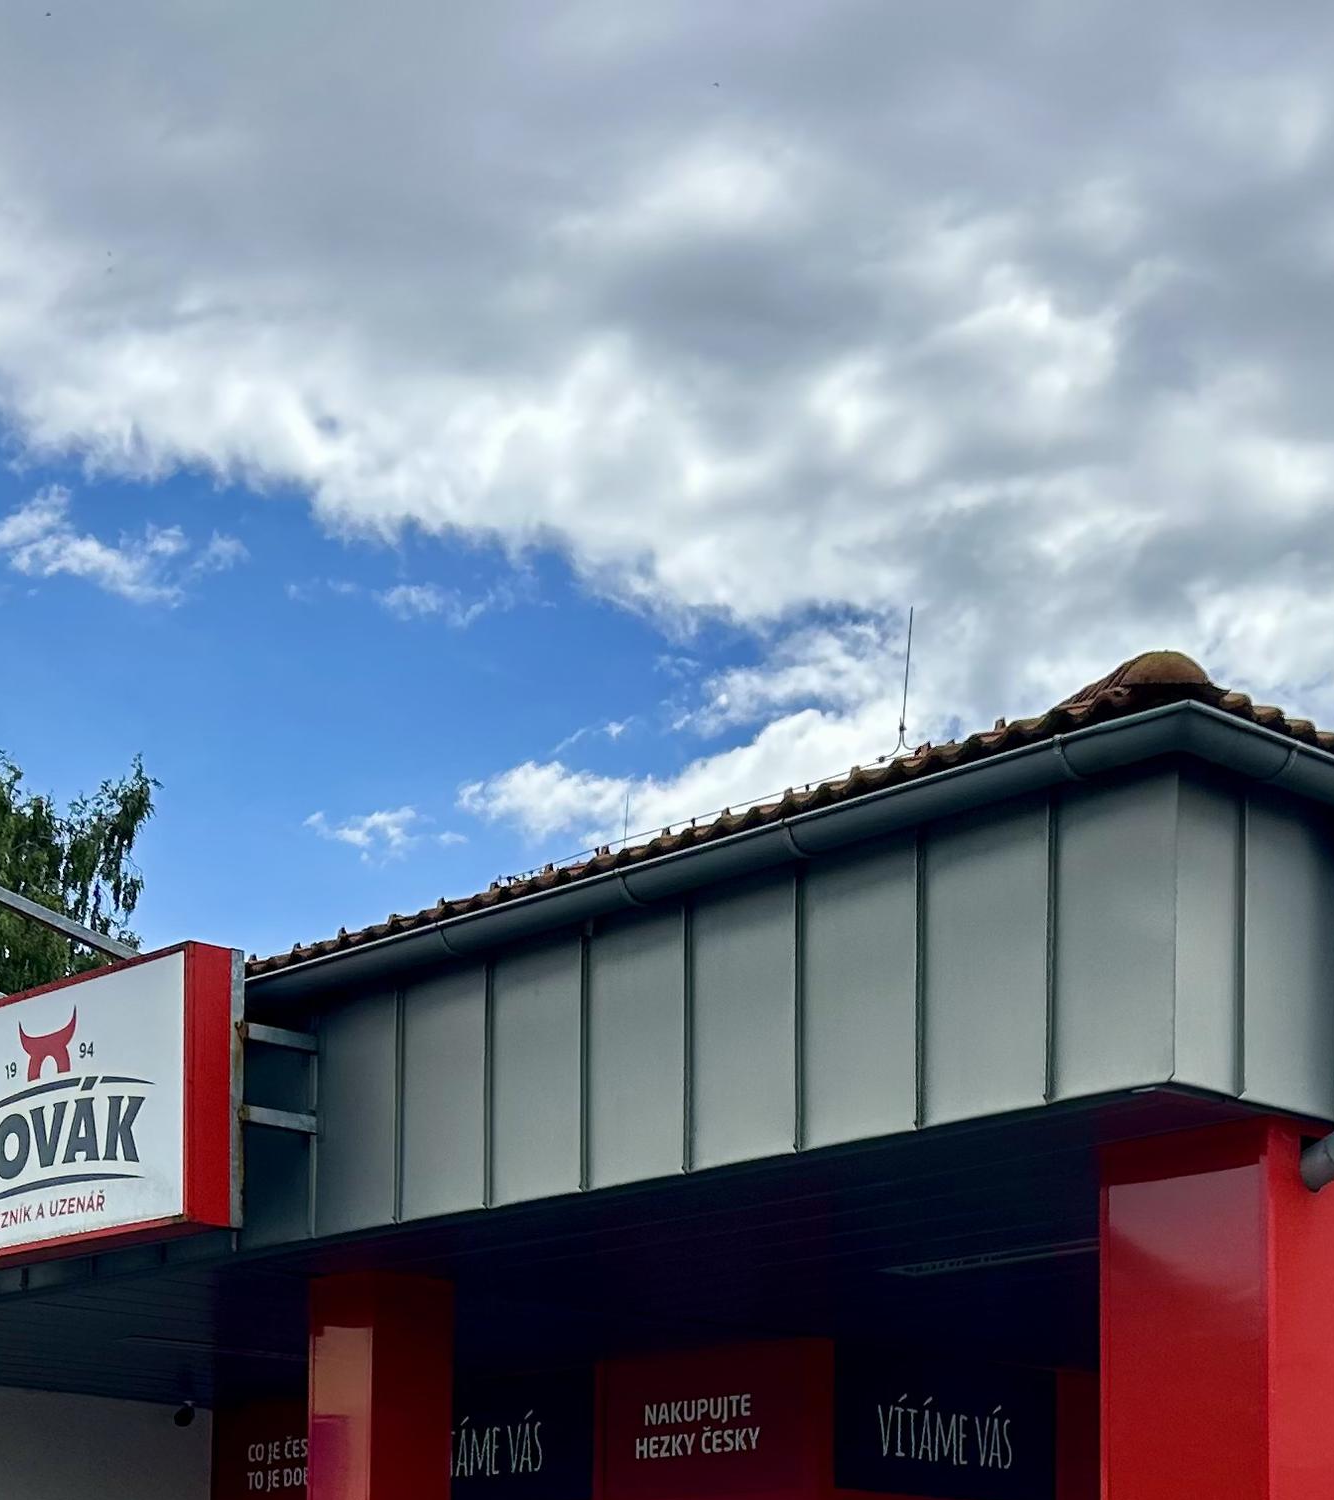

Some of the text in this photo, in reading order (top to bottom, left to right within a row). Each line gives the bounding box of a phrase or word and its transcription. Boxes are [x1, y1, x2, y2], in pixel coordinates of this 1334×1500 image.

[5, 1042, 94, 1079] 19 94
[35, 1203, 45, 1219] A
[49, 1189, 105, 1217] UZENÁŘ
[644, 1393, 752, 1426] NAKUPUJTE
[507, 1409, 543, 1474] VÁS
[635, 1426, 761, 1460] HEZKY ČESKY
[877, 1393, 1013, 1469] VÍTÁME VÁS
[248, 1443, 265, 1462] CO
[267, 1441, 281, 1464] JE
[247, 1471, 264, 1490] TO
[266, 1468, 280, 1492] JE
